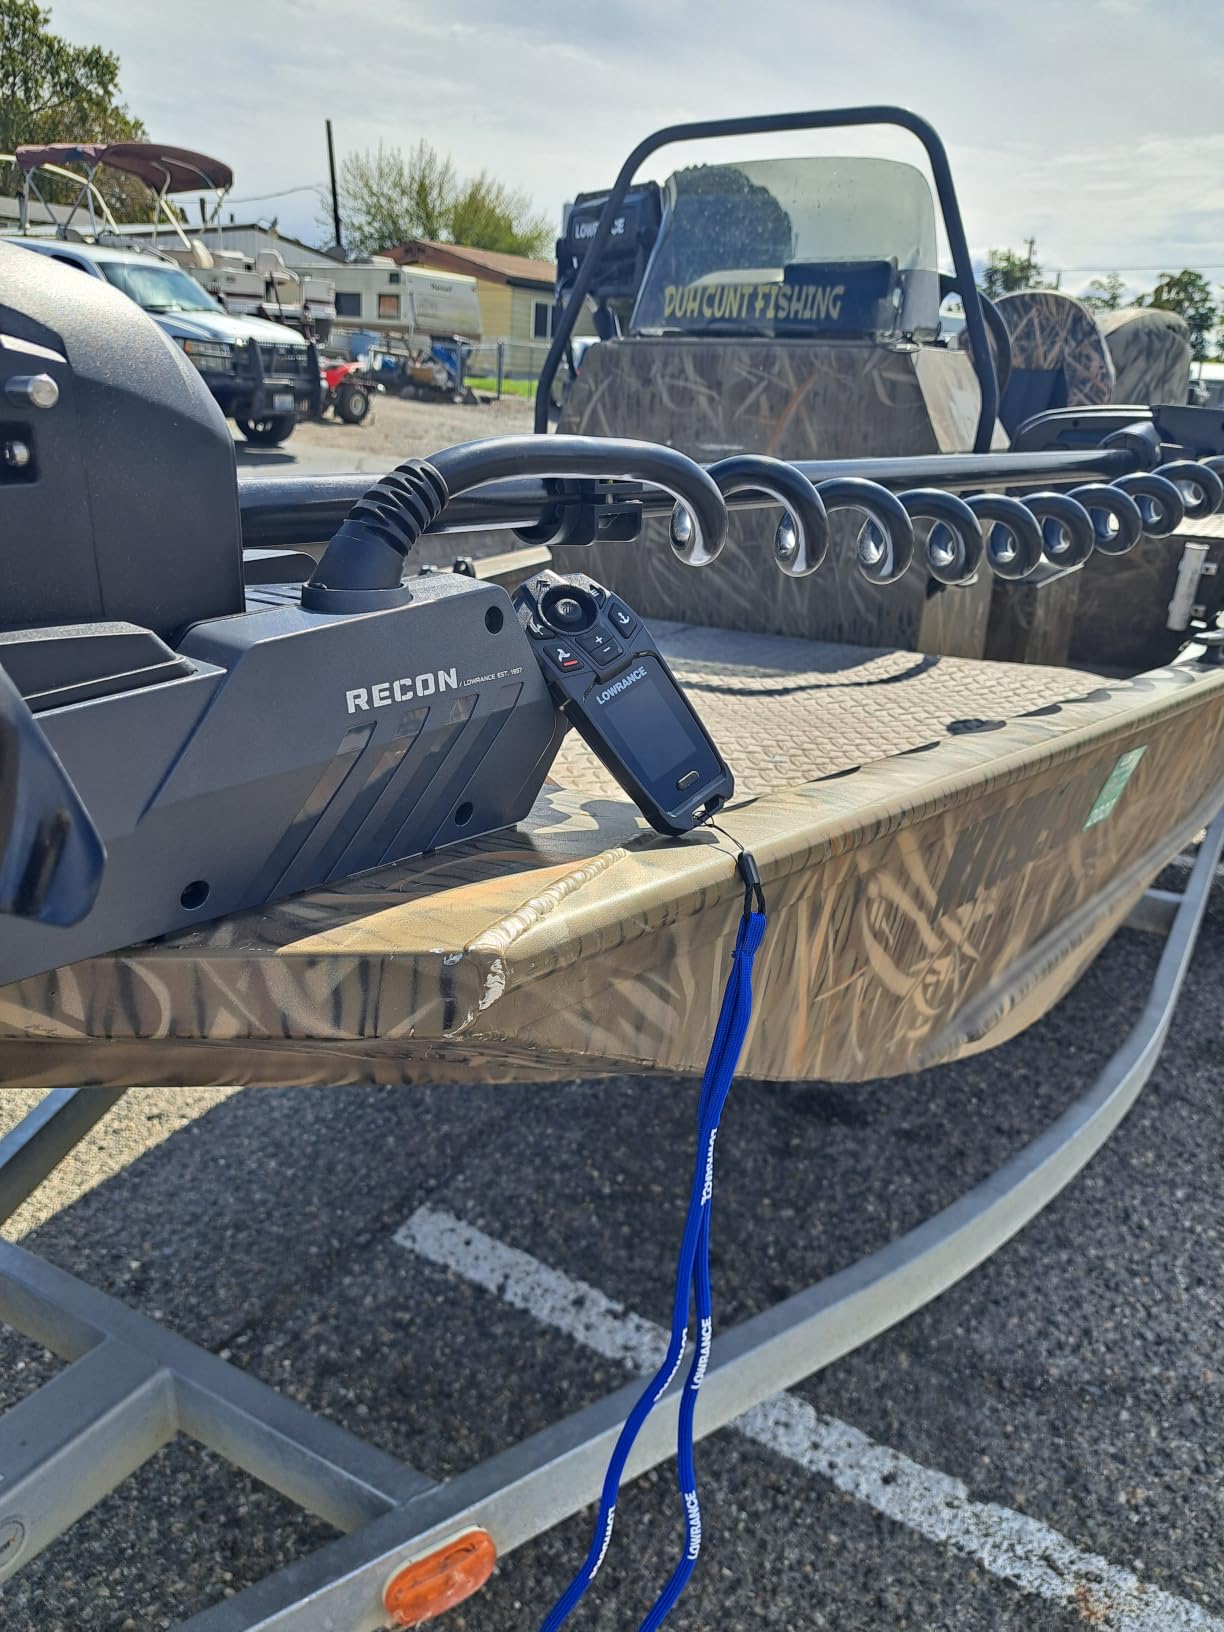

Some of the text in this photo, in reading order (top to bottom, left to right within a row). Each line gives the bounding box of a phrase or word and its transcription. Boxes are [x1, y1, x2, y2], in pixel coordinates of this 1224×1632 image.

[754, 285, 845, 320] FISHING
[346, 667, 458, 714] RECON
[463, 673, 496, 687] LOWRANCE
[510, 666, 523, 675] 1957
[595, 666, 648, 705] LOWRANCE
[690, 1315, 712, 1390] LOWRANCE
[684, 1489, 702, 1560] LOWRANCE
